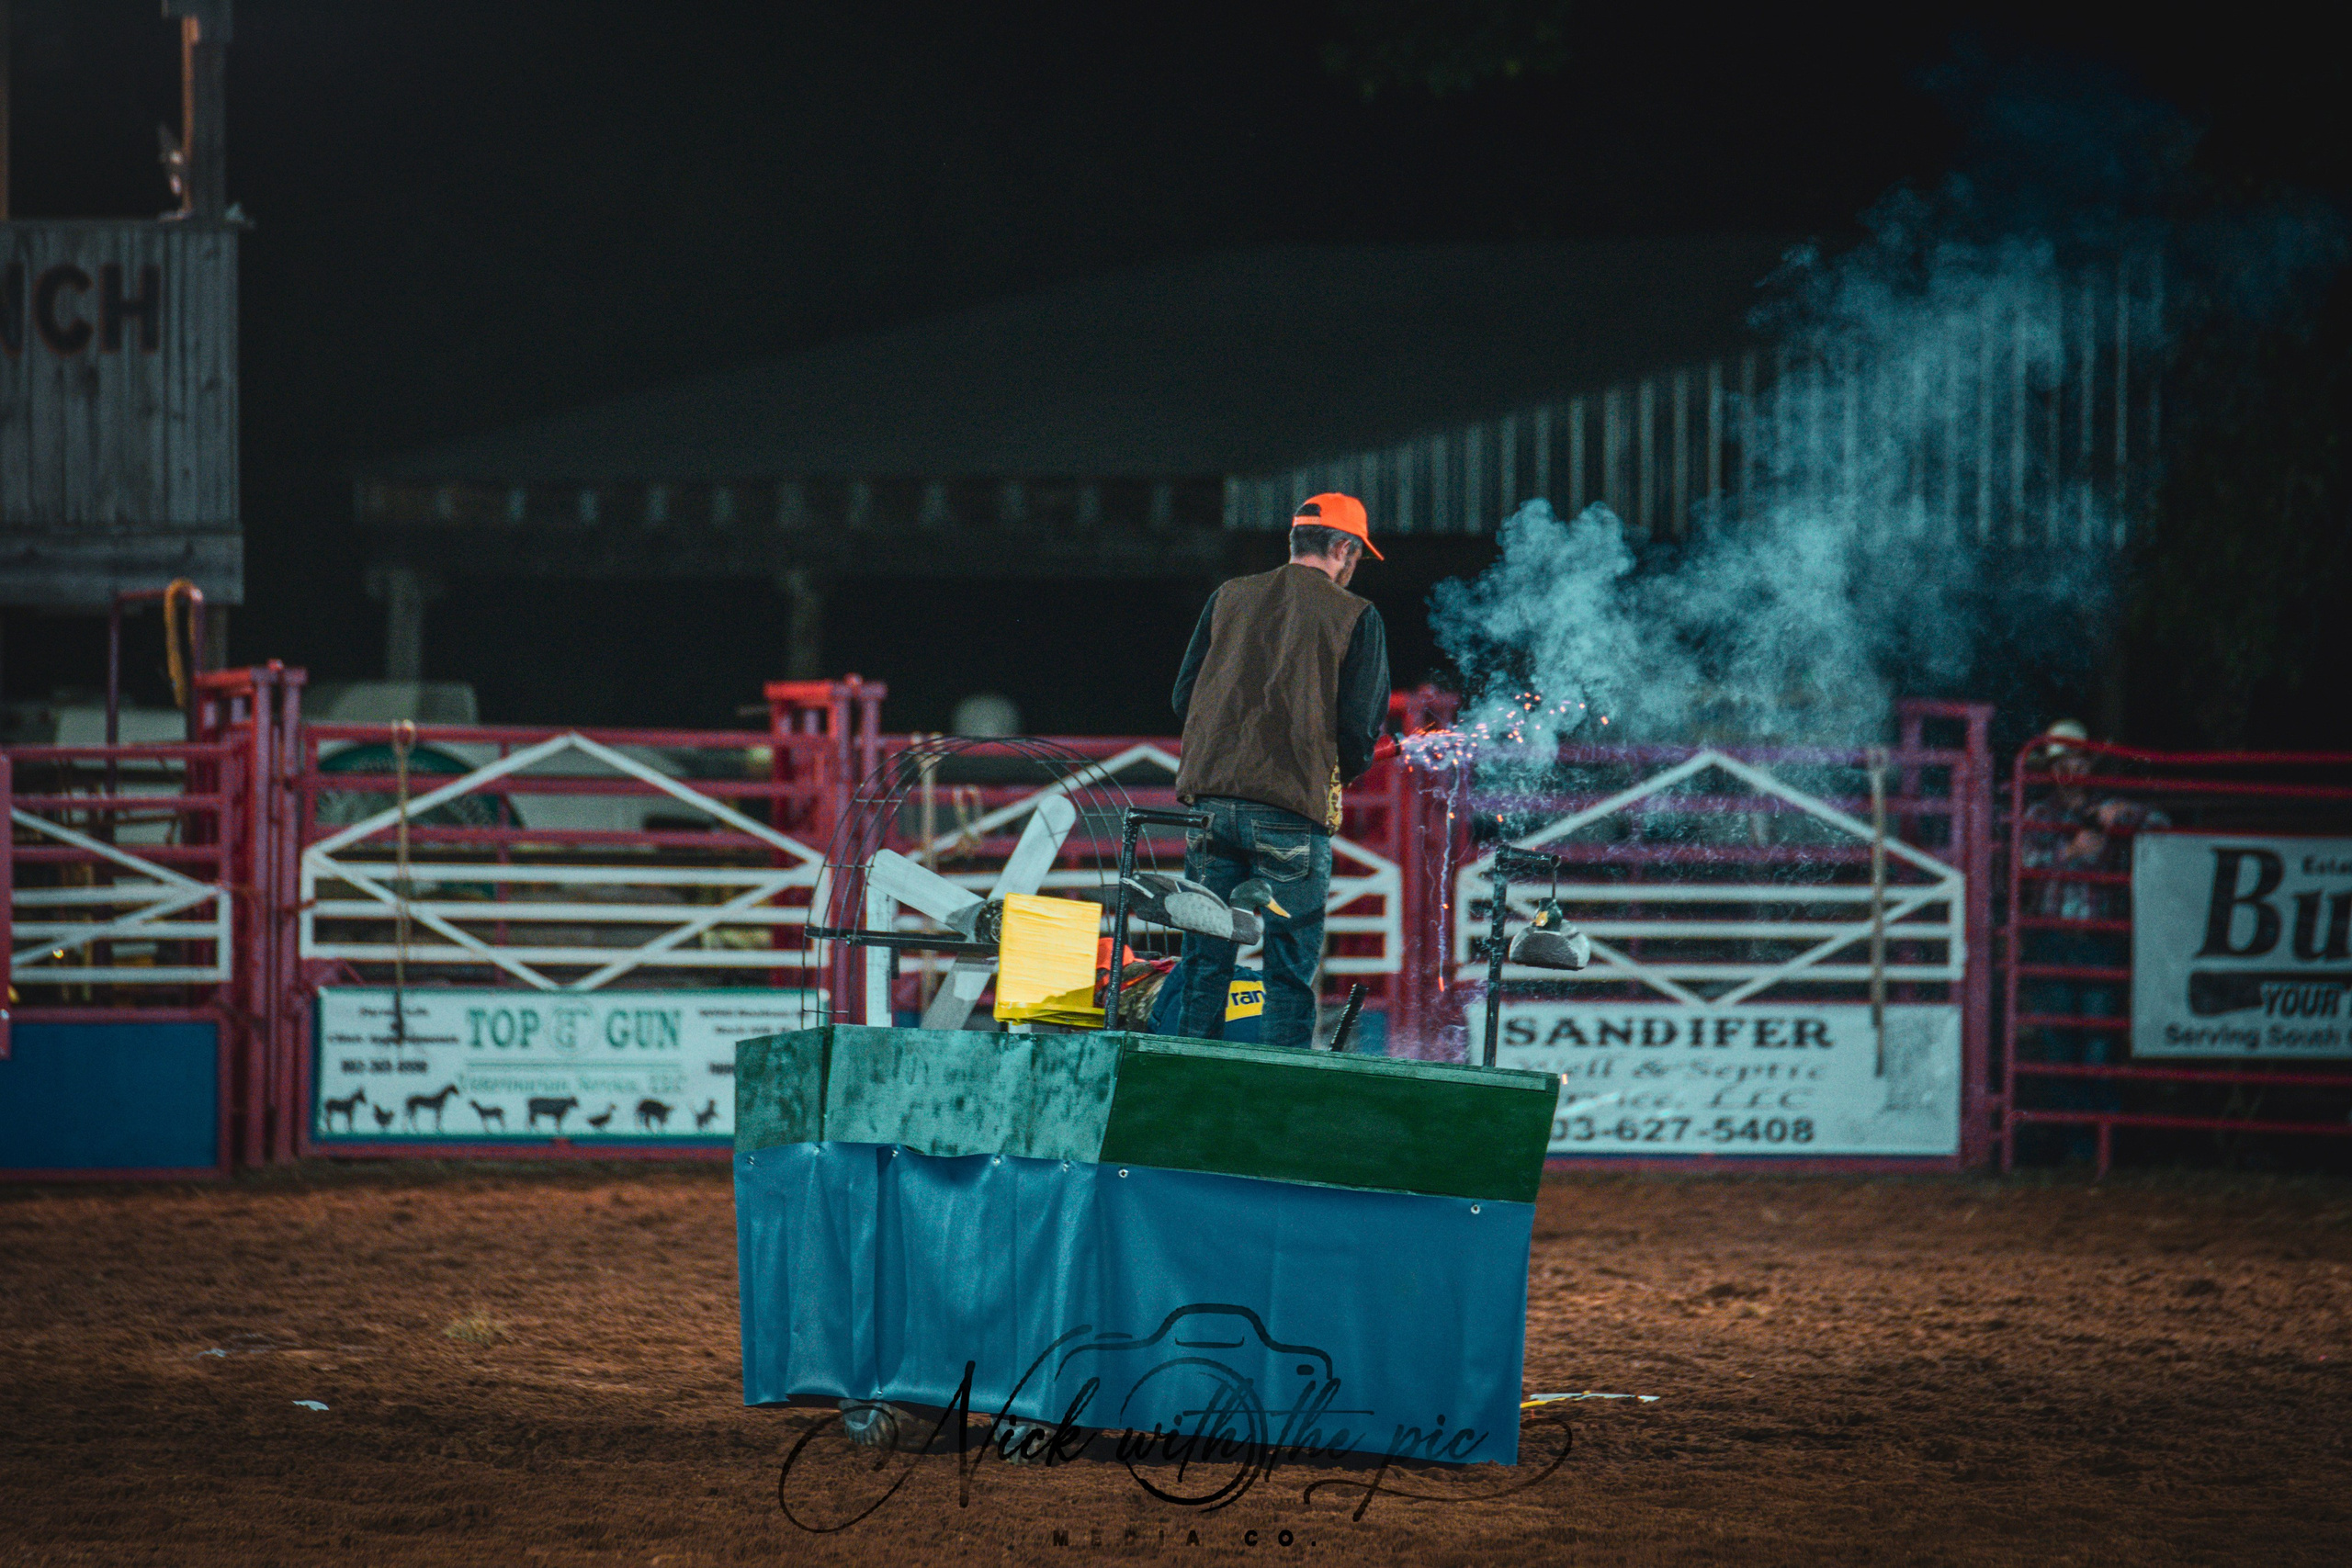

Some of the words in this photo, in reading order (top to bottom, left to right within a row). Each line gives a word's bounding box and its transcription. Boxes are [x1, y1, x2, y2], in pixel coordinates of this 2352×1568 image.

[2263, 987, 2341, 1017] YOUR
[465, 1009, 541, 1049] TOP
[604, 1009, 682, 1049] GUN
[1502, 1015, 1835, 1049] SANDIFER
[2165, 1022, 2259, 1050] Serving
[2267, 1023, 2341, 1046] South
[1686, 1056, 1828, 1084] Septic
